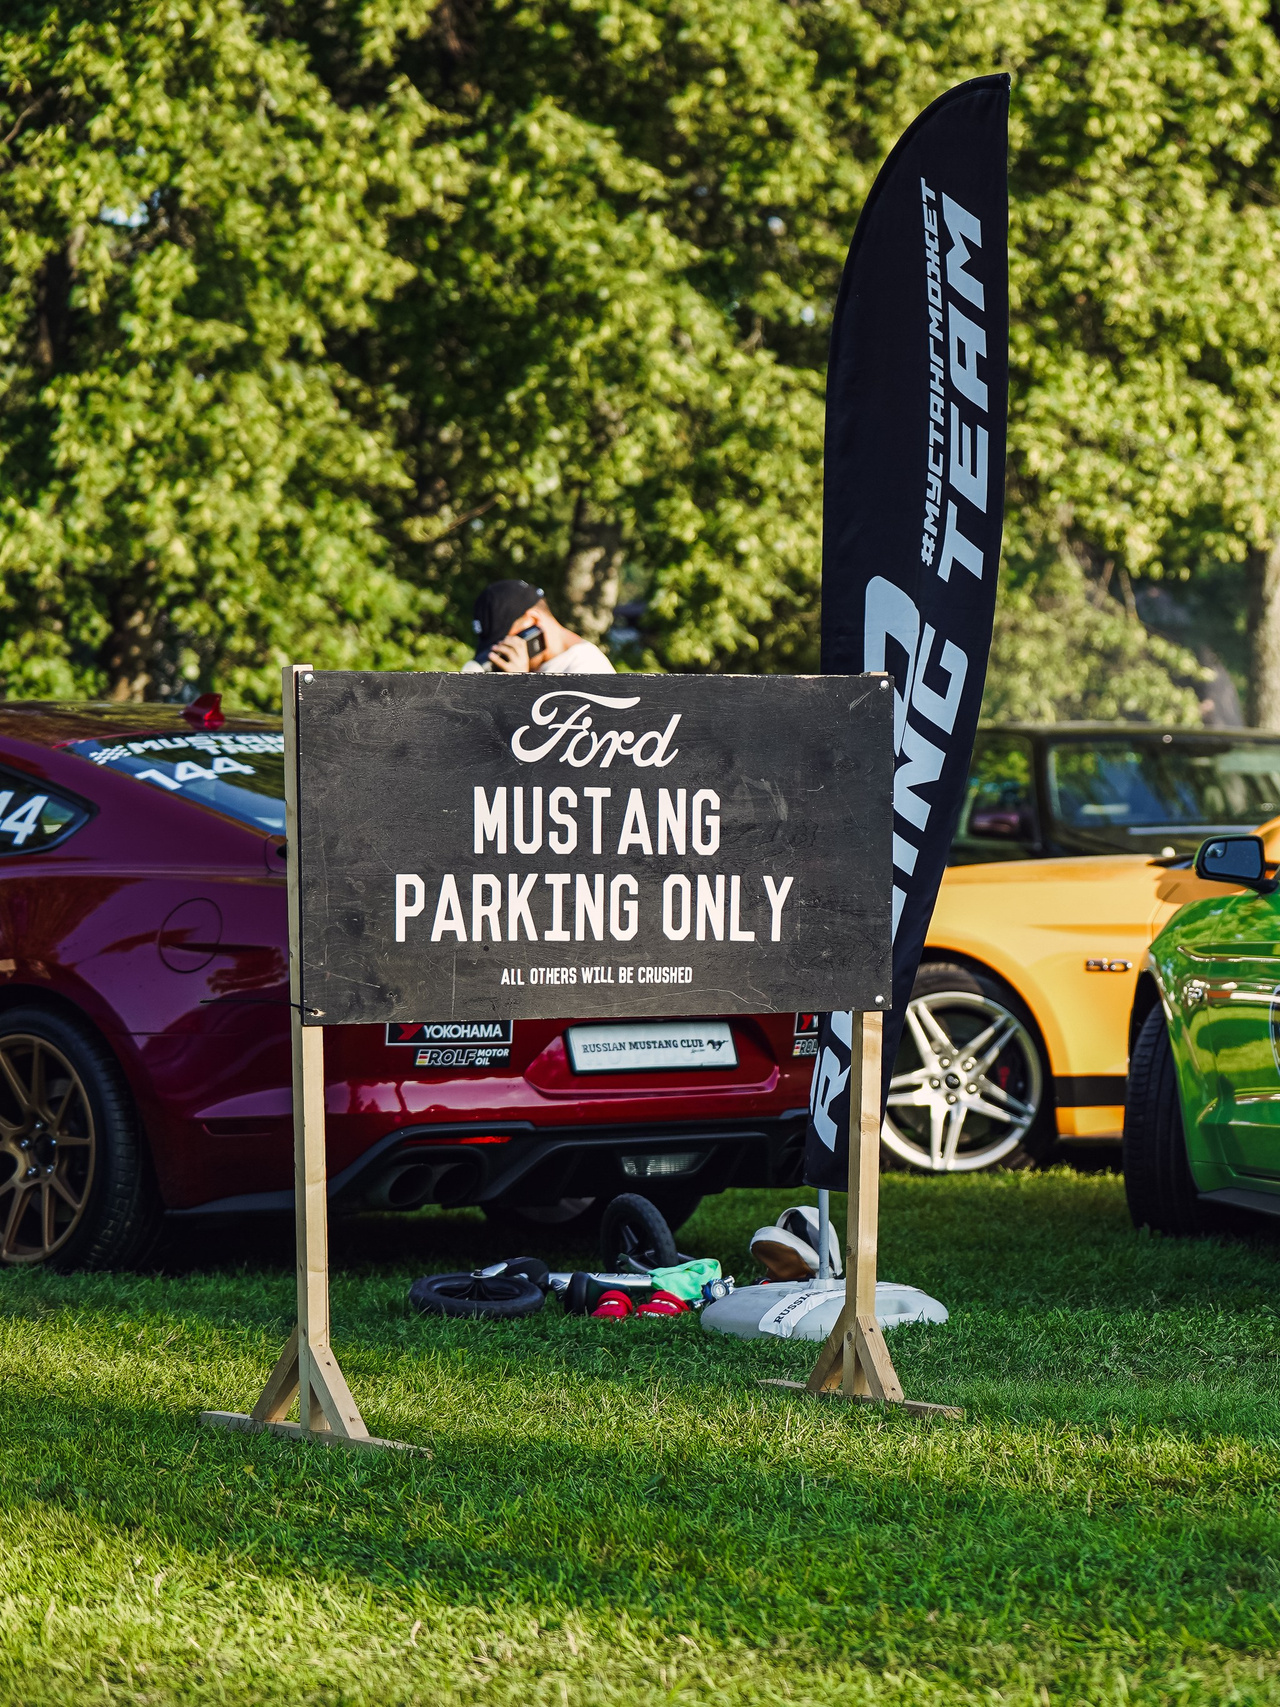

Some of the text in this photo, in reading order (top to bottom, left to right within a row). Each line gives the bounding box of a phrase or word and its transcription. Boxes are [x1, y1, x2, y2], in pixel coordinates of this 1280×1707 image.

[937, 191, 989, 583] TEAM
[511, 690, 682, 768] Ford
[127, 735, 285, 754] MUSTAN
[134, 757, 256, 790] 144
[473, 786, 721, 855] MUSTANG
[395, 873, 794, 942] PARKING ONLY
[500, 966, 693, 985] ALL OTHERS WILL BE CRUSHED
[424, 1023, 503, 1039] YOKOHAMA
[582, 1042, 627, 1053] RUSSIAN
[628, 1040, 679, 1051] MUSTANG
[680, 1038, 705, 1049] CLUB
[427, 1049, 510, 1066] ROLF MOTOR
[475, 1057, 491, 1066] OIL
